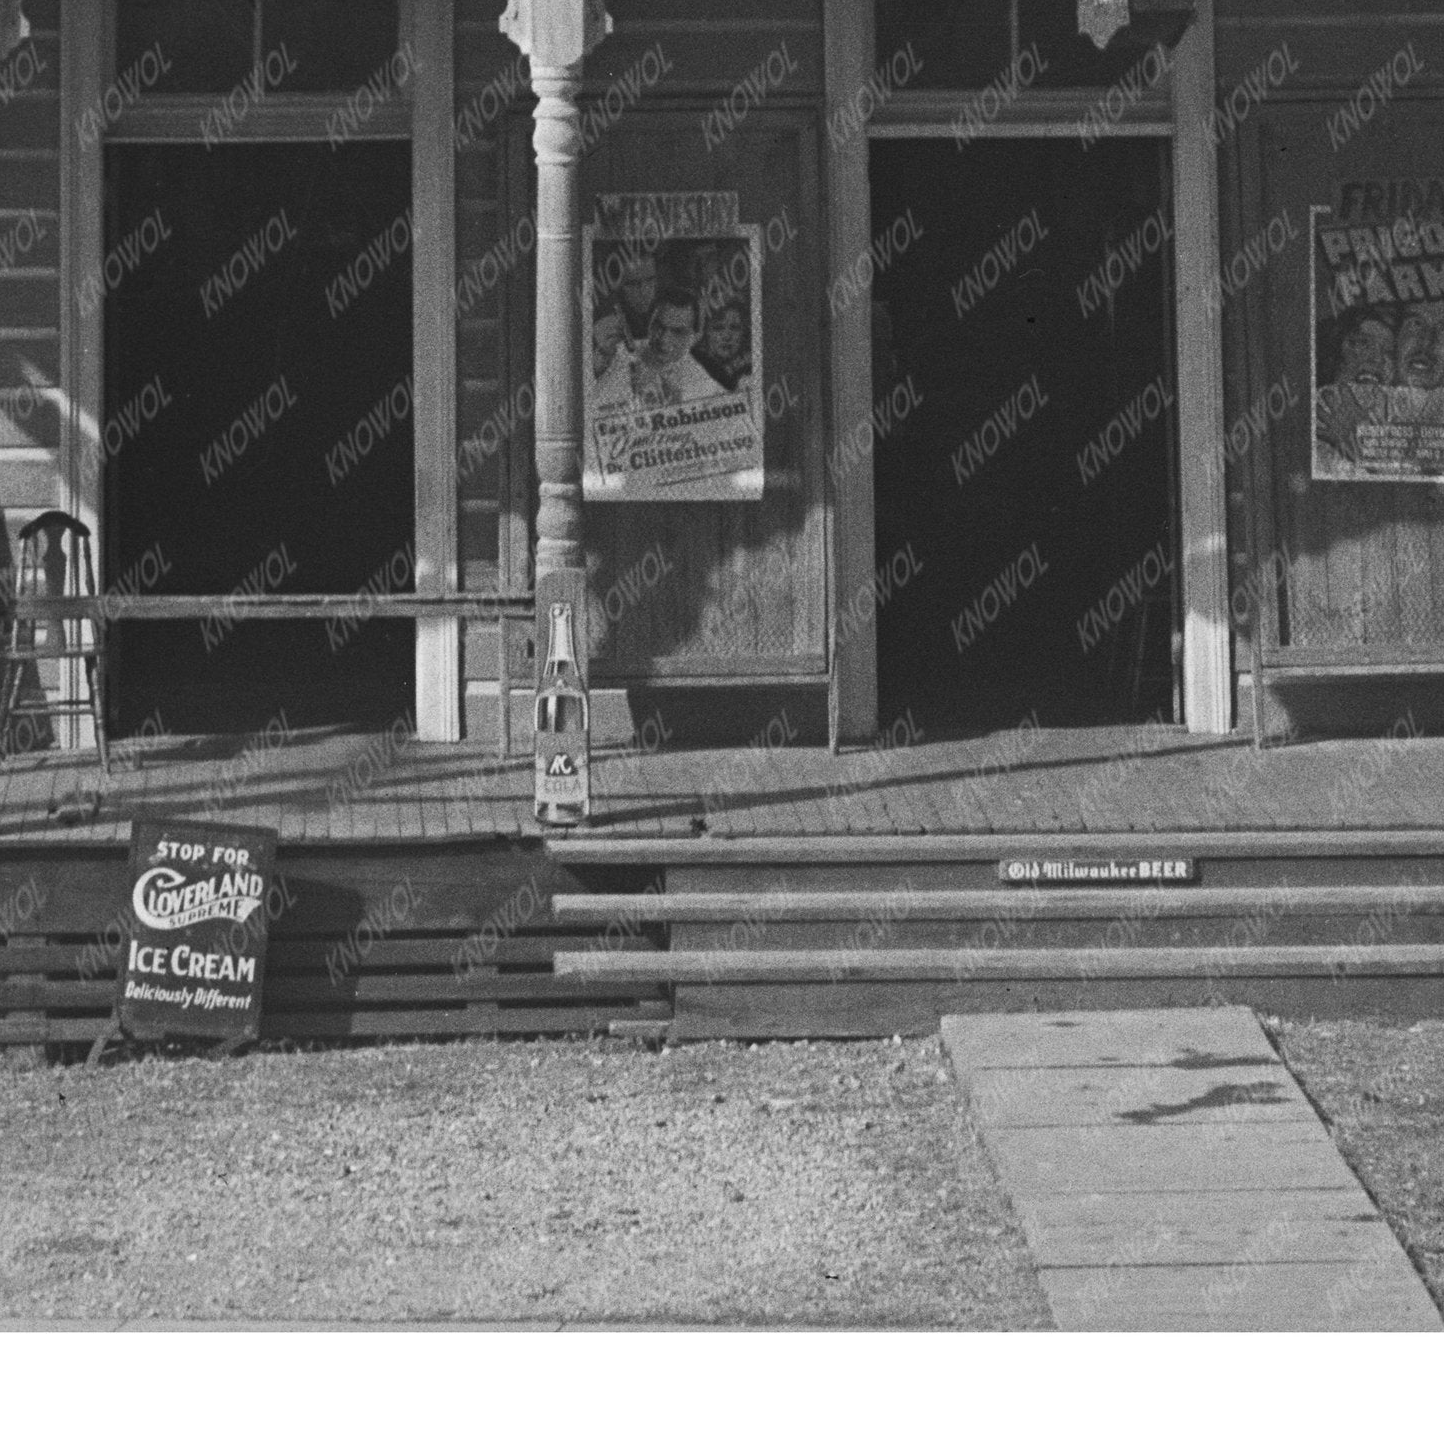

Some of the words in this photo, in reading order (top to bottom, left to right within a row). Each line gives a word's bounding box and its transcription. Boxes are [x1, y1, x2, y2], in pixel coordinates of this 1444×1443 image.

[650, 401, 747, 431] Robinson
[157, 841, 205, 860] STOP
[212, 847, 249, 865] FOR
[1008, 861, 1039, 879] Old
[1043, 861, 1137, 879] Milwaukee
[1139, 861, 1187, 879] BEER
[132, 867, 263, 930] CLOVERLAND
[168, 900, 244, 927] SUPREME
[128, 940, 167, 976] ICE
[171, 945, 255, 983] CREAM
[125, 980, 194, 1008] Deliciously
[194, 987, 252, 1010] Different
